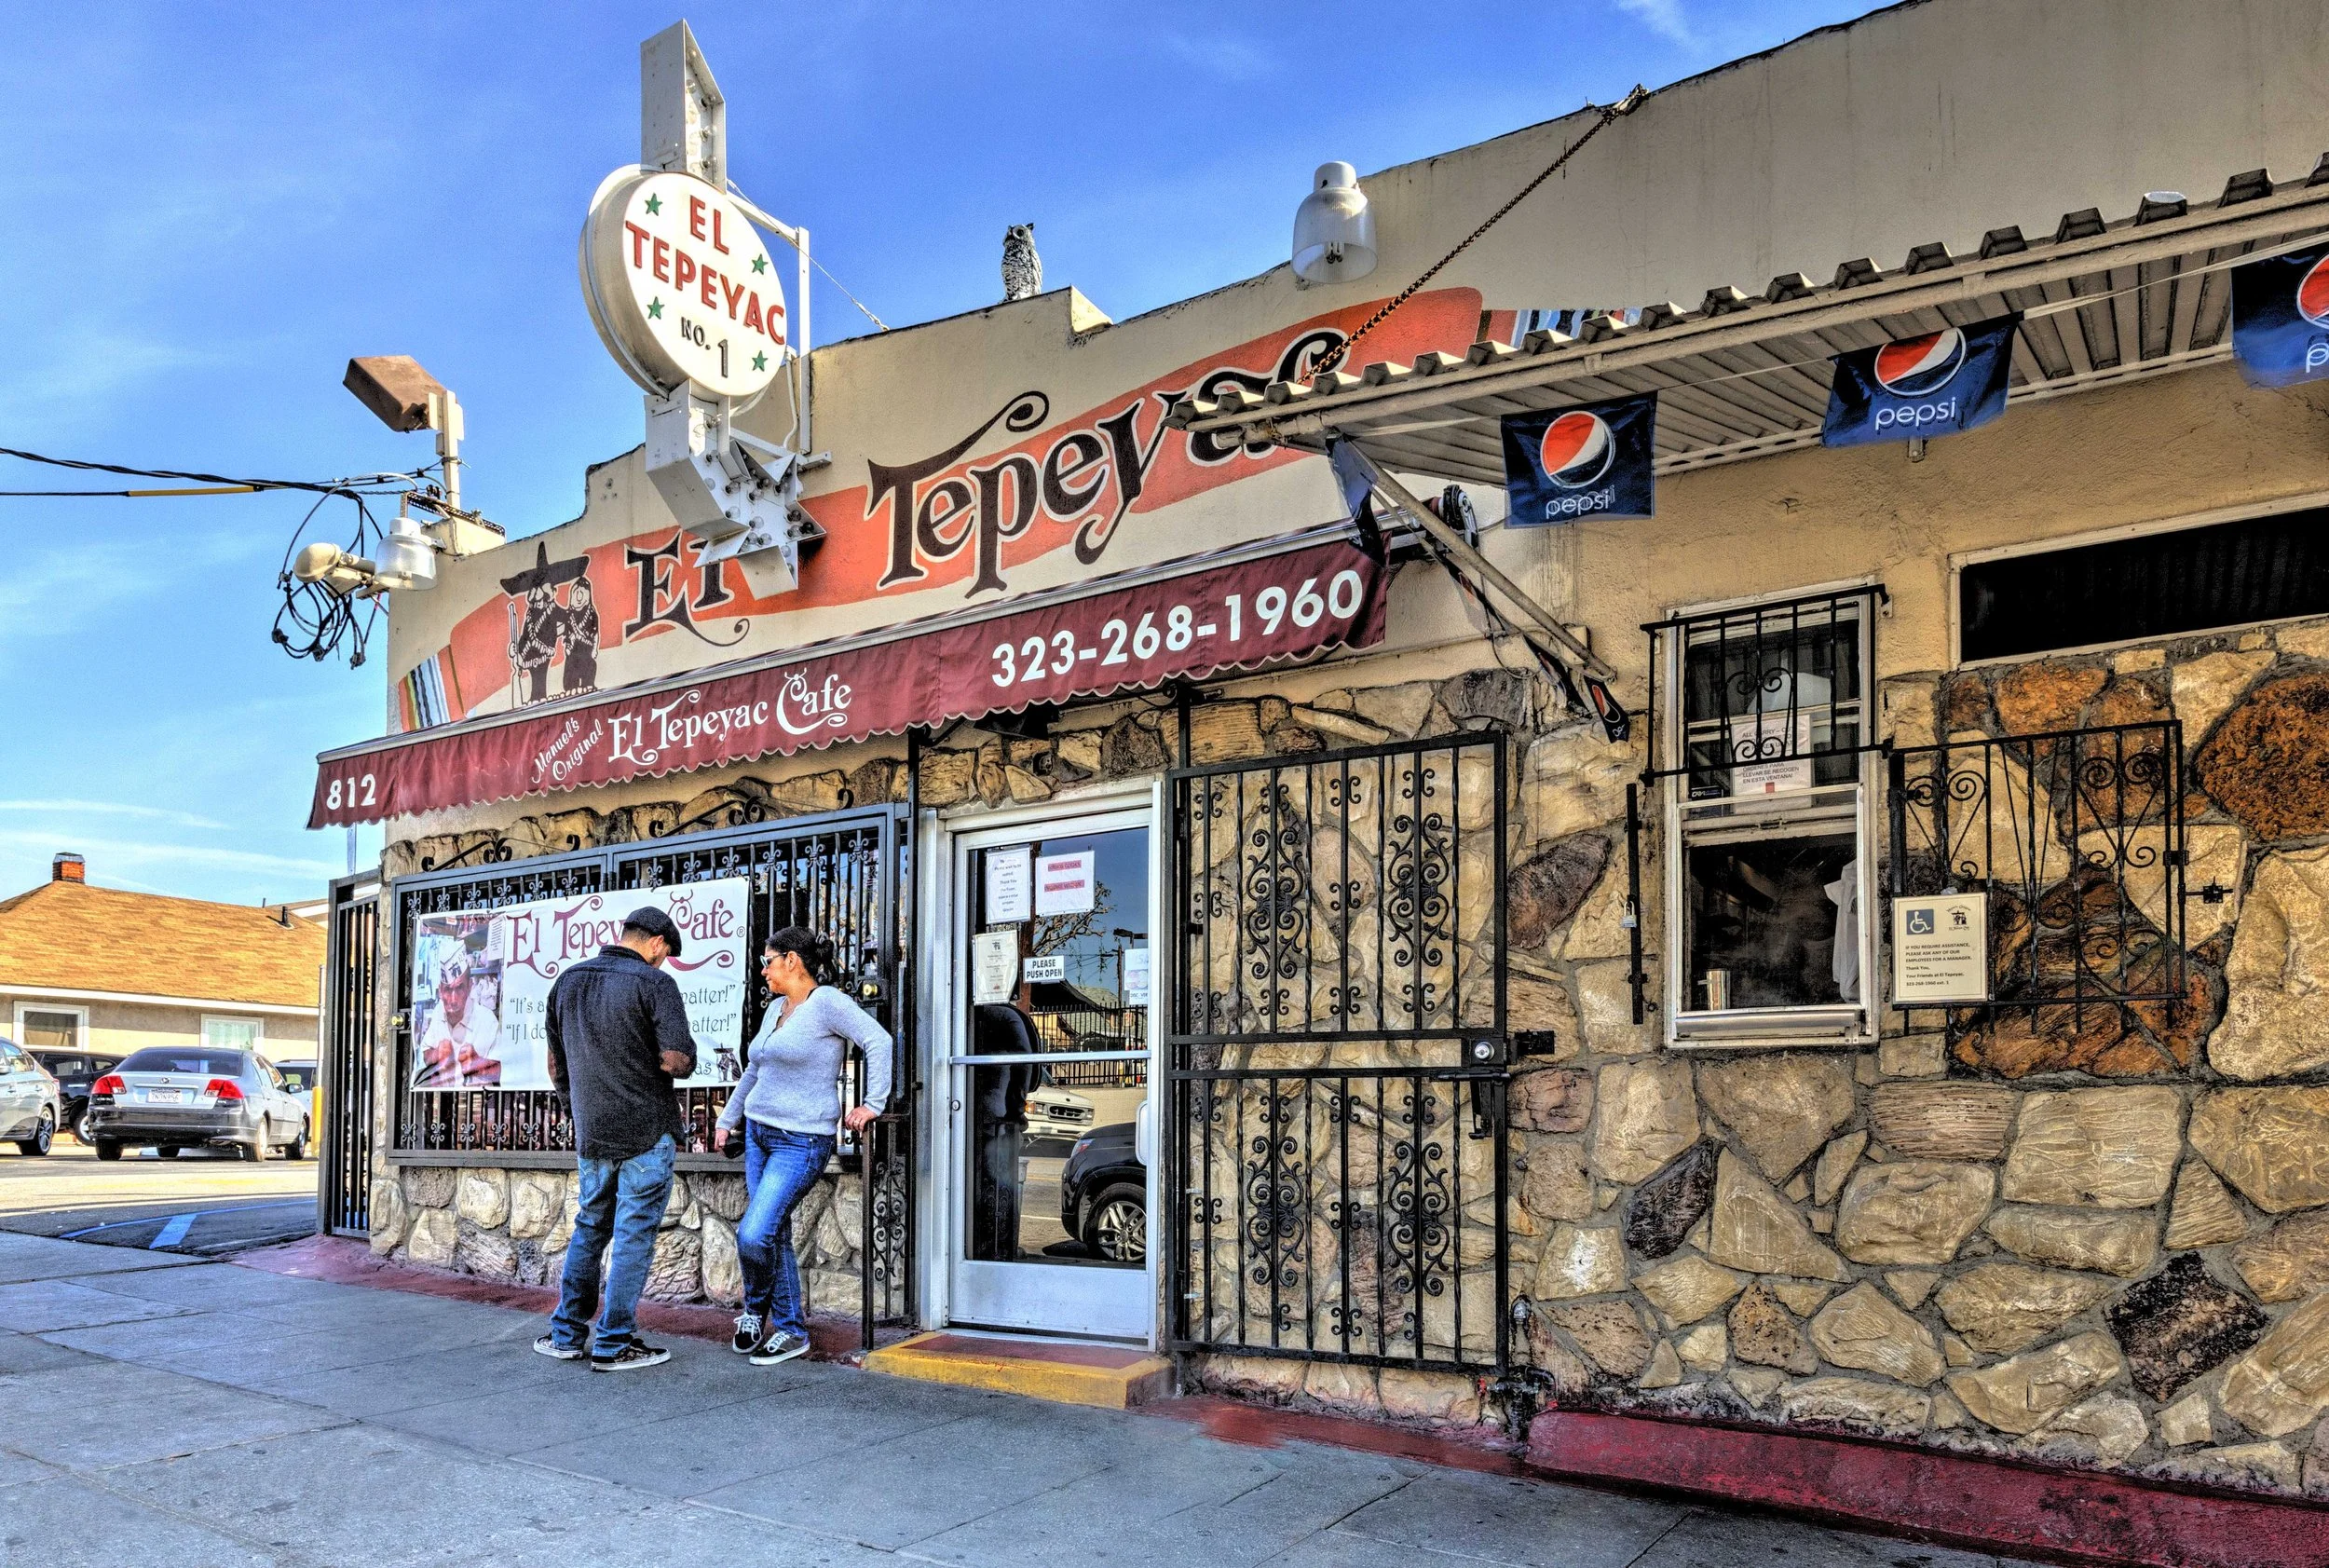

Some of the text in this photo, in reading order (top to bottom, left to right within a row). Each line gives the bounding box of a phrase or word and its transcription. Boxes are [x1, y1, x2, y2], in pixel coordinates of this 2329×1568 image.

[690, 195, 729, 255] EL
[625, 220, 785, 346] TEPEYAC
[681, 316, 729, 378] NO. 1
[1874, 396, 1956, 430] pepsi
[1546, 486, 1613, 519] pepsi
[991, 569, 1363, 688] 323-268-1960
[607, 667, 852, 766] El Tepeyac Cafe
[531, 716, 580, 784] Manuel's
[552, 718, 604, 781] Original
[1772, 766, 1800, 774] RECOGEN
[326, 773, 376, 811] 812
[505, 909, 560, 980] El
[1026, 968, 1063, 979] PUSH OPEN
[1032, 959, 1056, 969] PLEASE
[688, 1013, 737, 1035] atter!"
